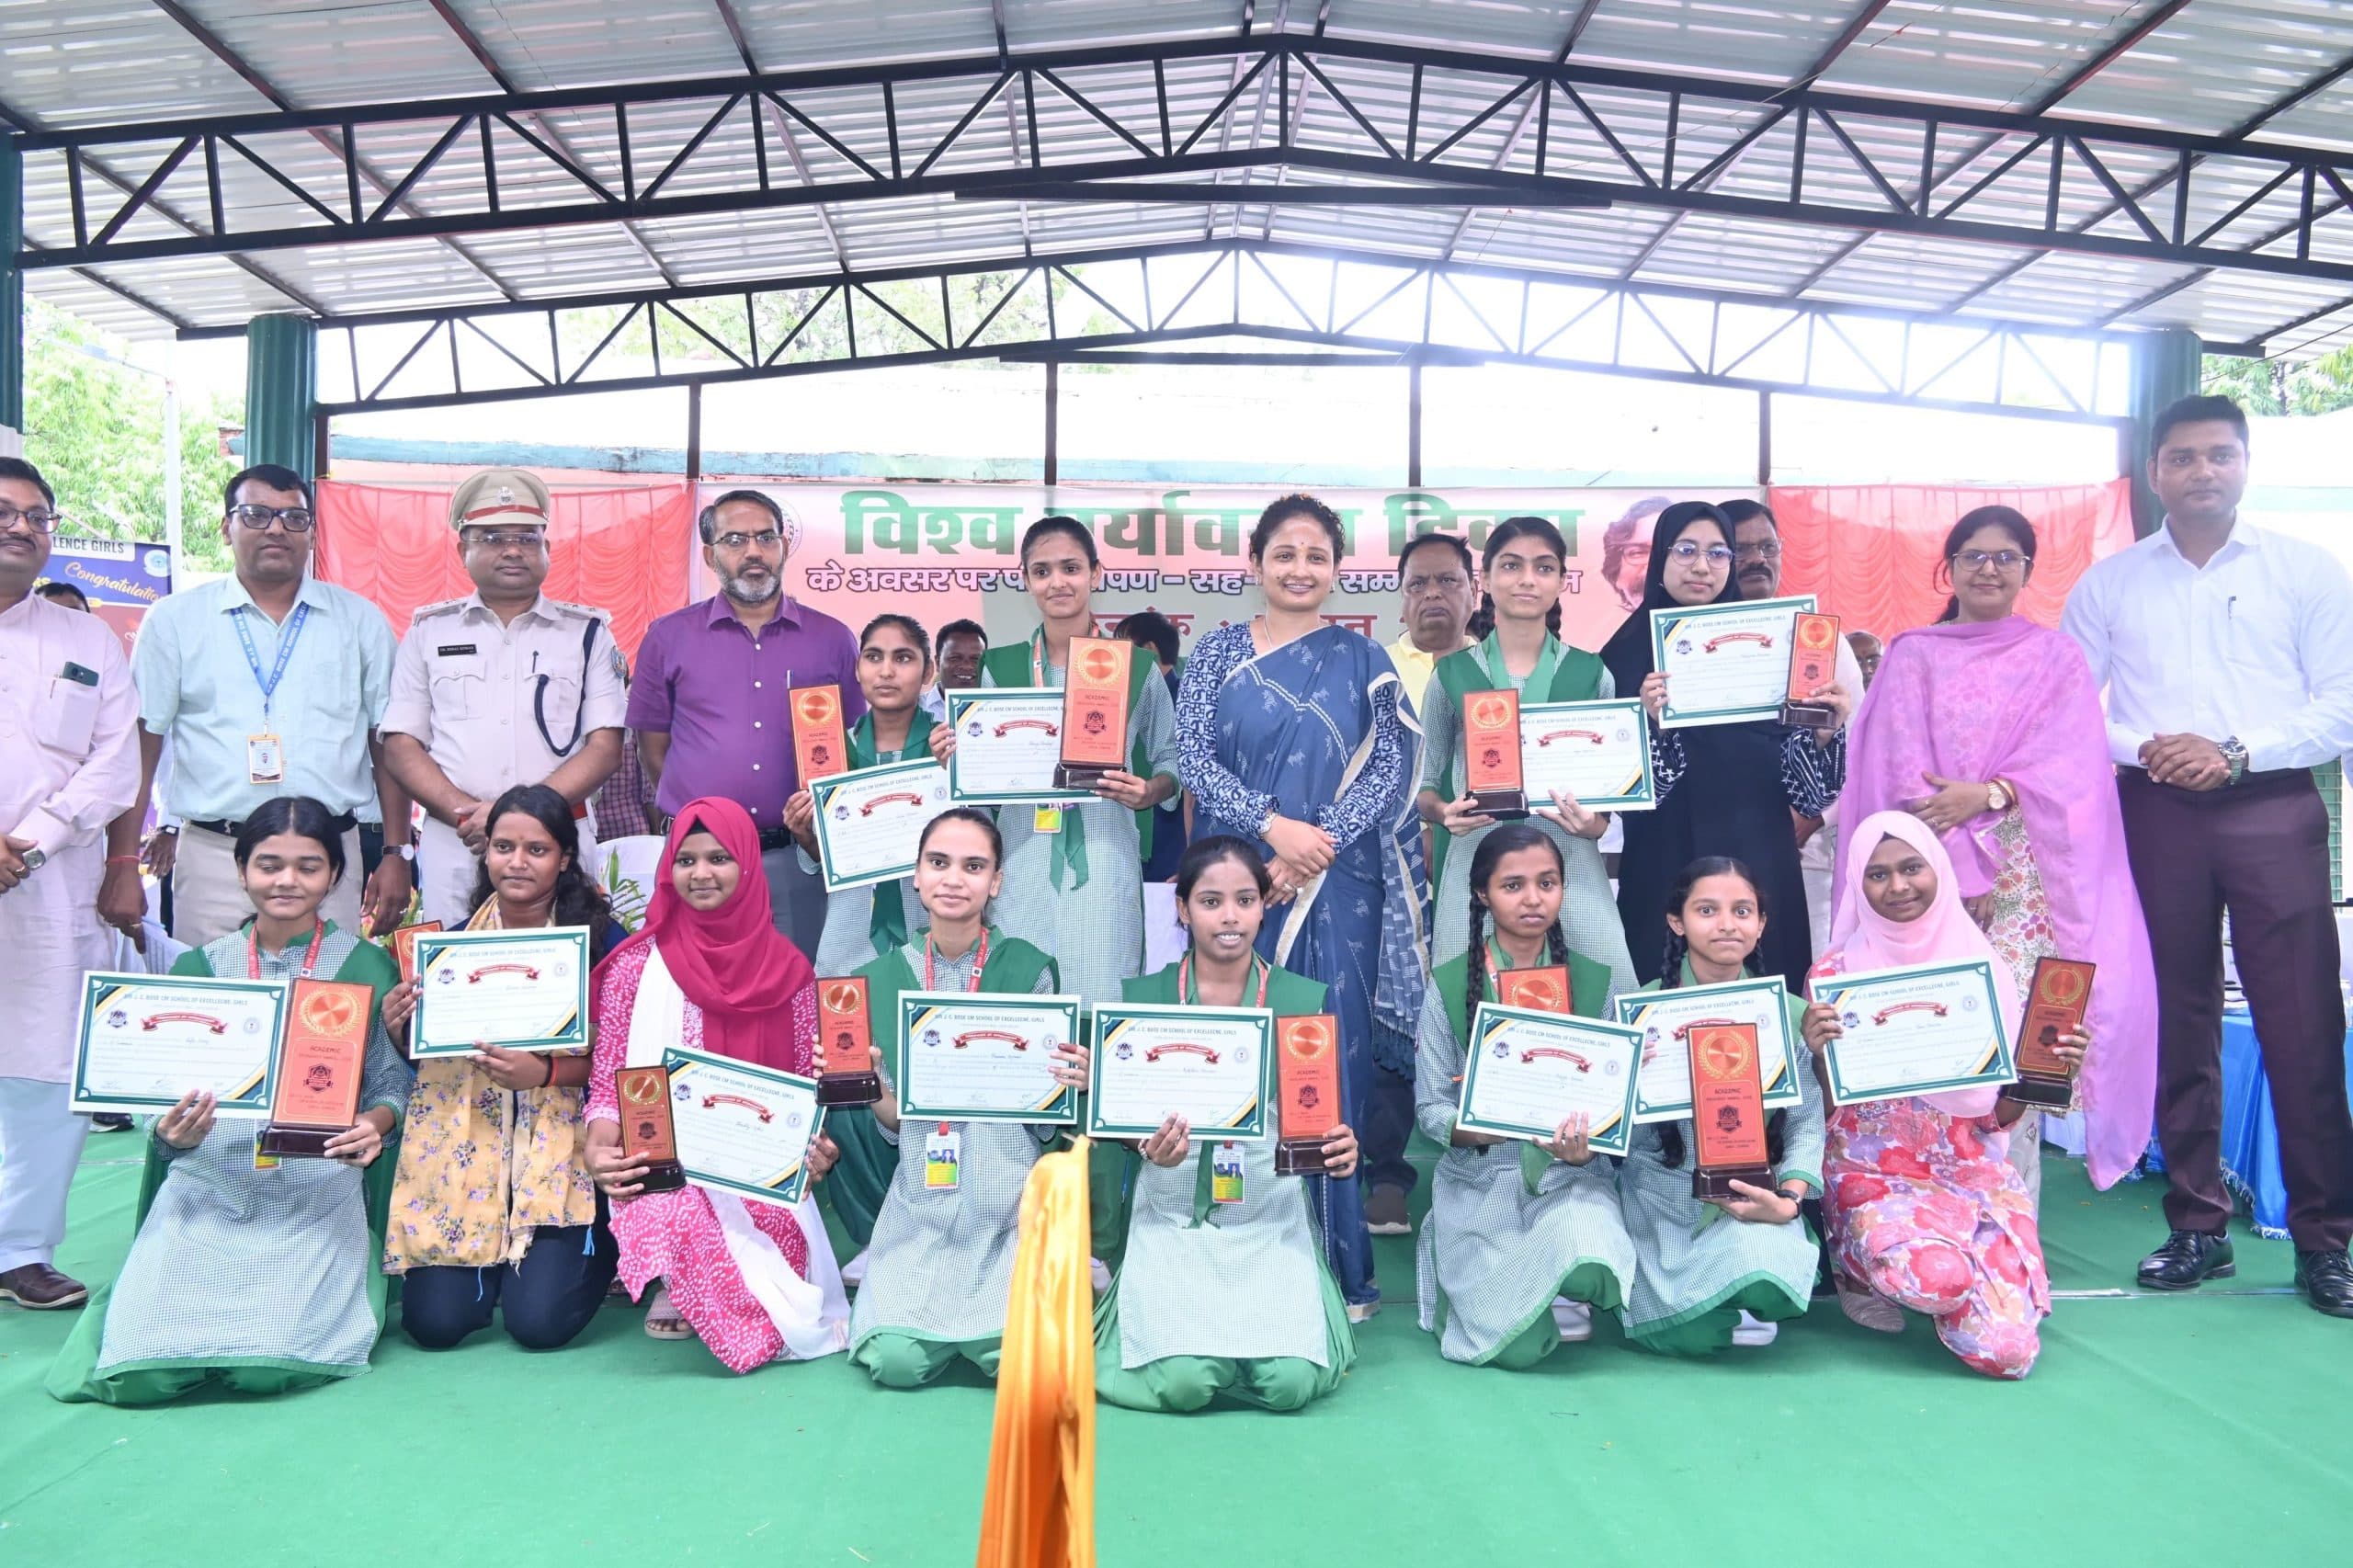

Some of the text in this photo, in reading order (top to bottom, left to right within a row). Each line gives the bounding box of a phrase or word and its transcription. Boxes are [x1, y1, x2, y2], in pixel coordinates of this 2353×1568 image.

[840, 491, 1024, 555] विश्व
[1043, 490, 1362, 556] र्याव
[53, 537, 124, 553] LENCE GIRLS
[64, 562, 164, 602] Congratulatio
[806, 559, 845, 591] के
[847, 568, 952, 593] अवसर
[954, 567, 1002, 593] पर
